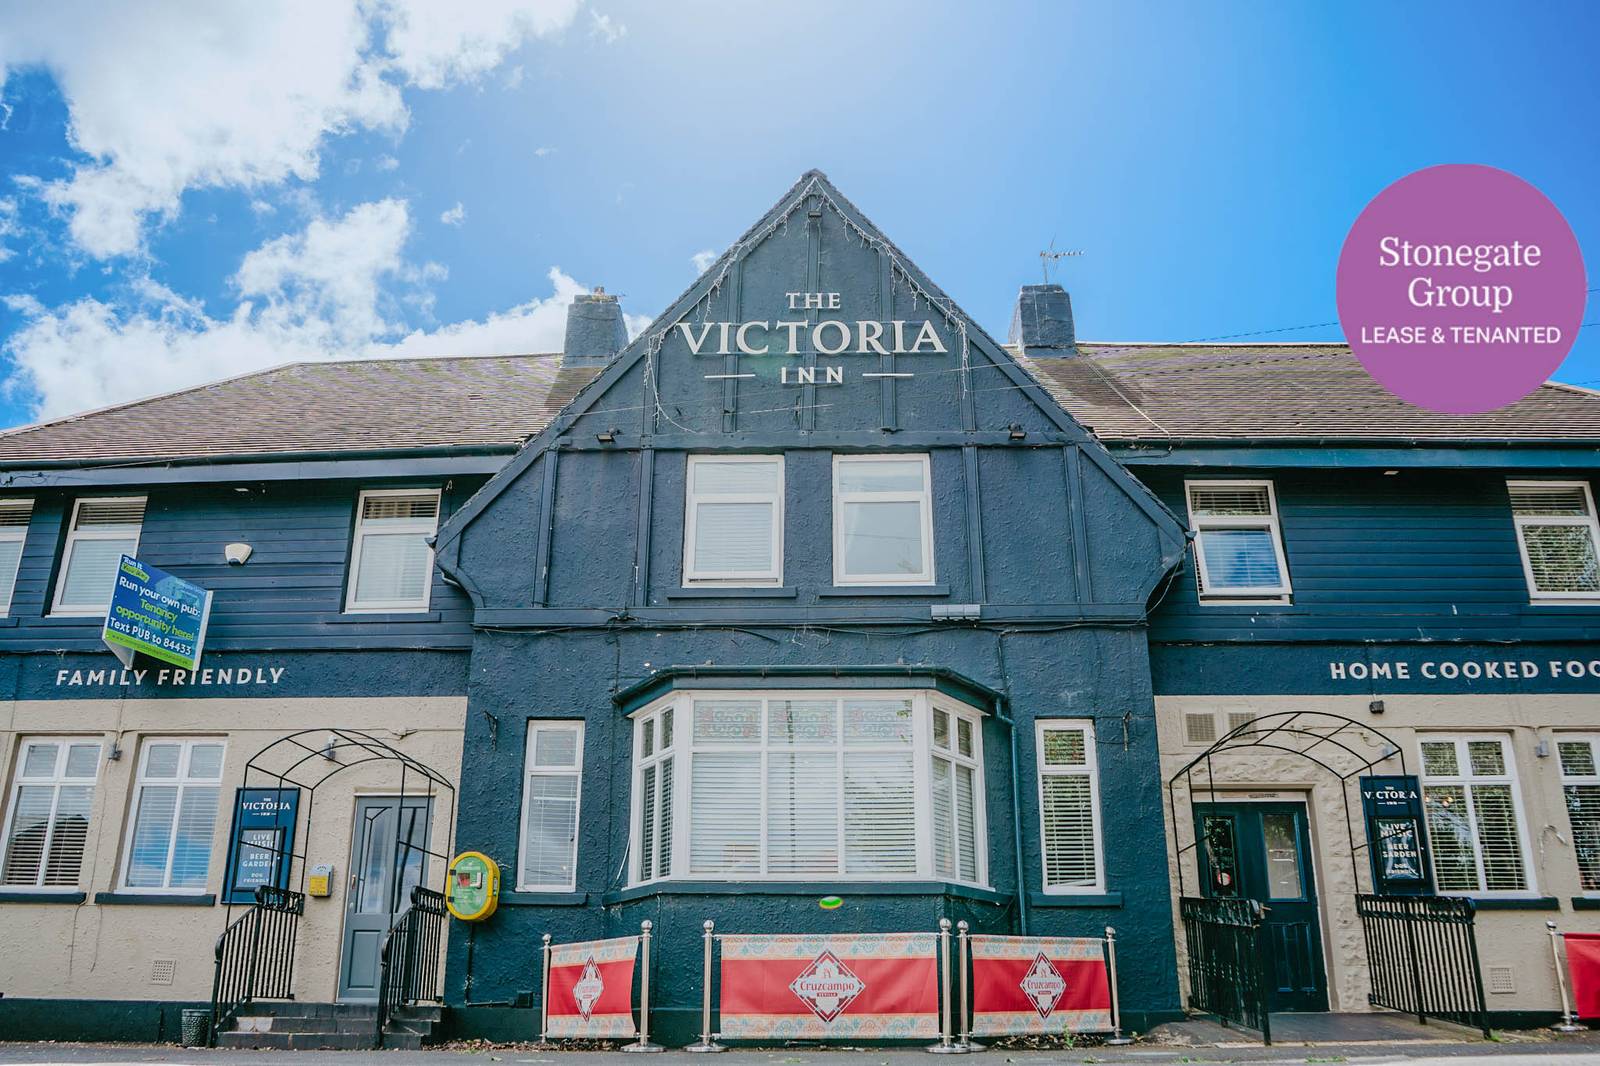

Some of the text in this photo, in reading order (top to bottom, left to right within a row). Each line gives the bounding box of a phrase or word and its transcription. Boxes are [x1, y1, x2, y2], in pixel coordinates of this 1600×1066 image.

[785, 292, 841, 309] THE
[677, 319, 948, 355] VICTORIA
[781, 366, 843, 384] INN
[119, 576, 201, 617] Run your own pub:
[140, 599, 178, 623] Tenancy
[115, 605, 194, 641] opportunity here!
[110, 617, 130, 633] Text
[132, 626, 150, 640] PUB
[152, 633, 162, 644] to
[163, 638, 192, 656] 84433
[56, 667, 285, 686] FAMILY FRIENDLY
[1329, 661, 1410, 680] HOME
[1420, 660, 1539, 679] COOKED
[1364, 791, 1418, 799] VCTORA
[800, 982, 855, 993] Cruzcampo
